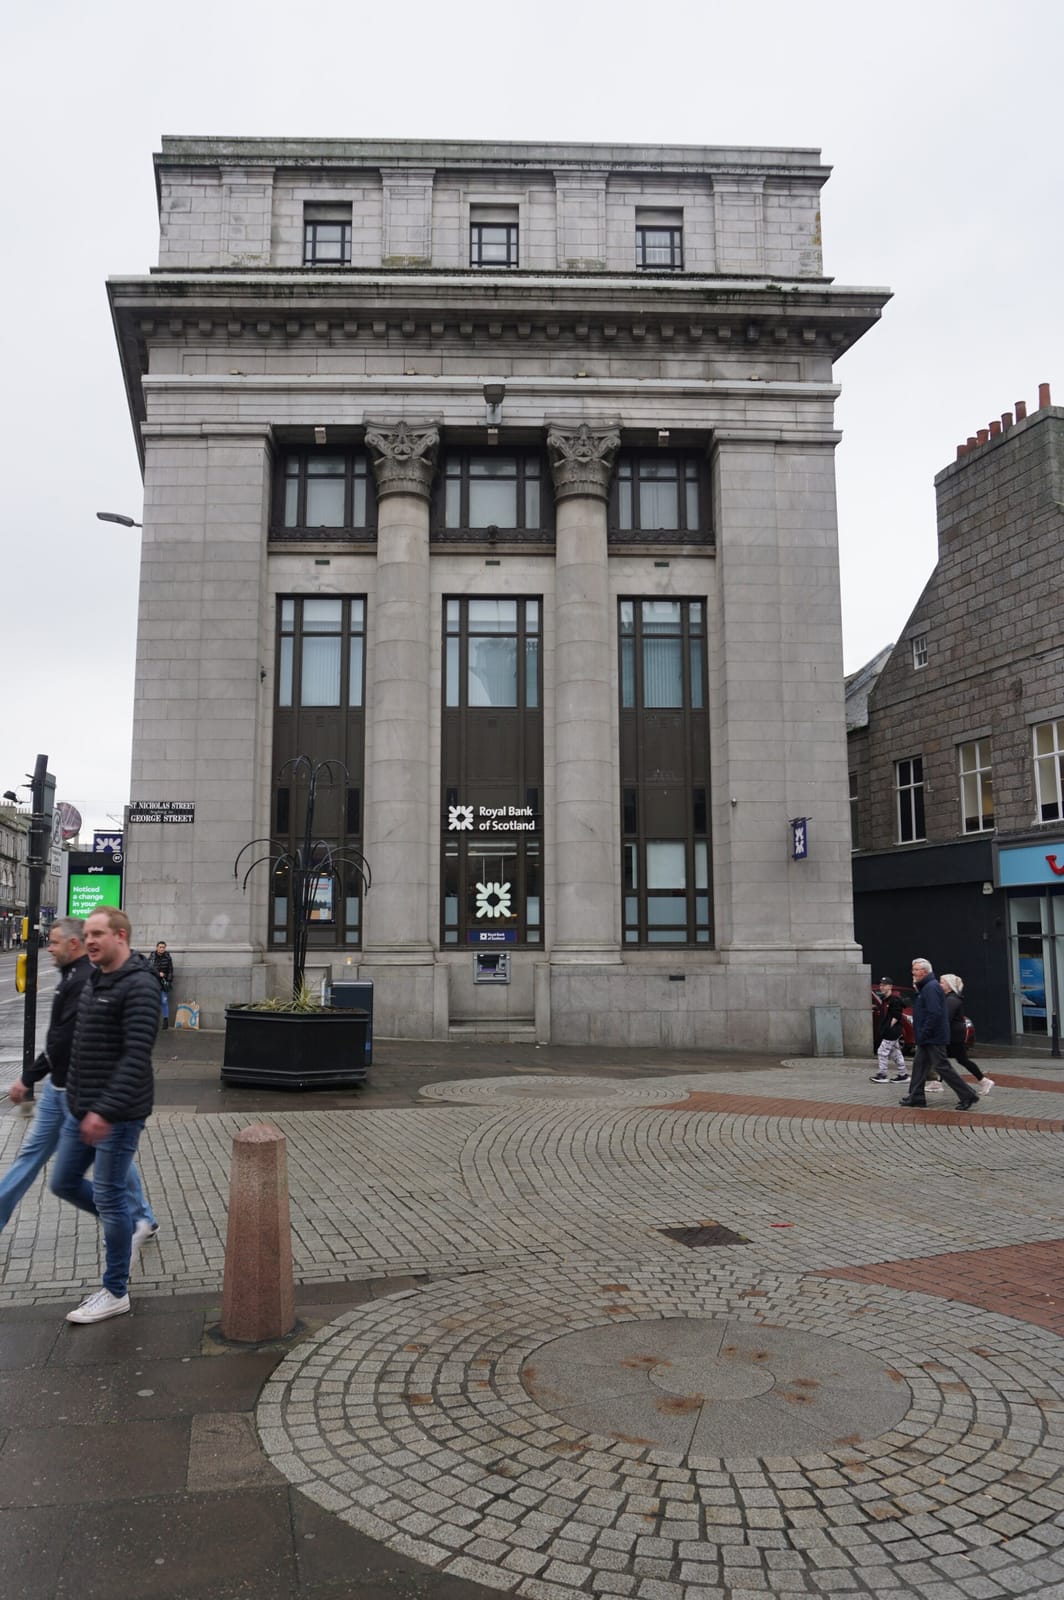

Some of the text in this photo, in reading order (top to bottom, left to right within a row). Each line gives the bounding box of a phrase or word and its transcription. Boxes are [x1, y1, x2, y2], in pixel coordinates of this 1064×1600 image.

[479, 806, 533, 819] Royal Bank
[479, 820, 535, 830] of Scotland
[79, 893, 104, 901] change
